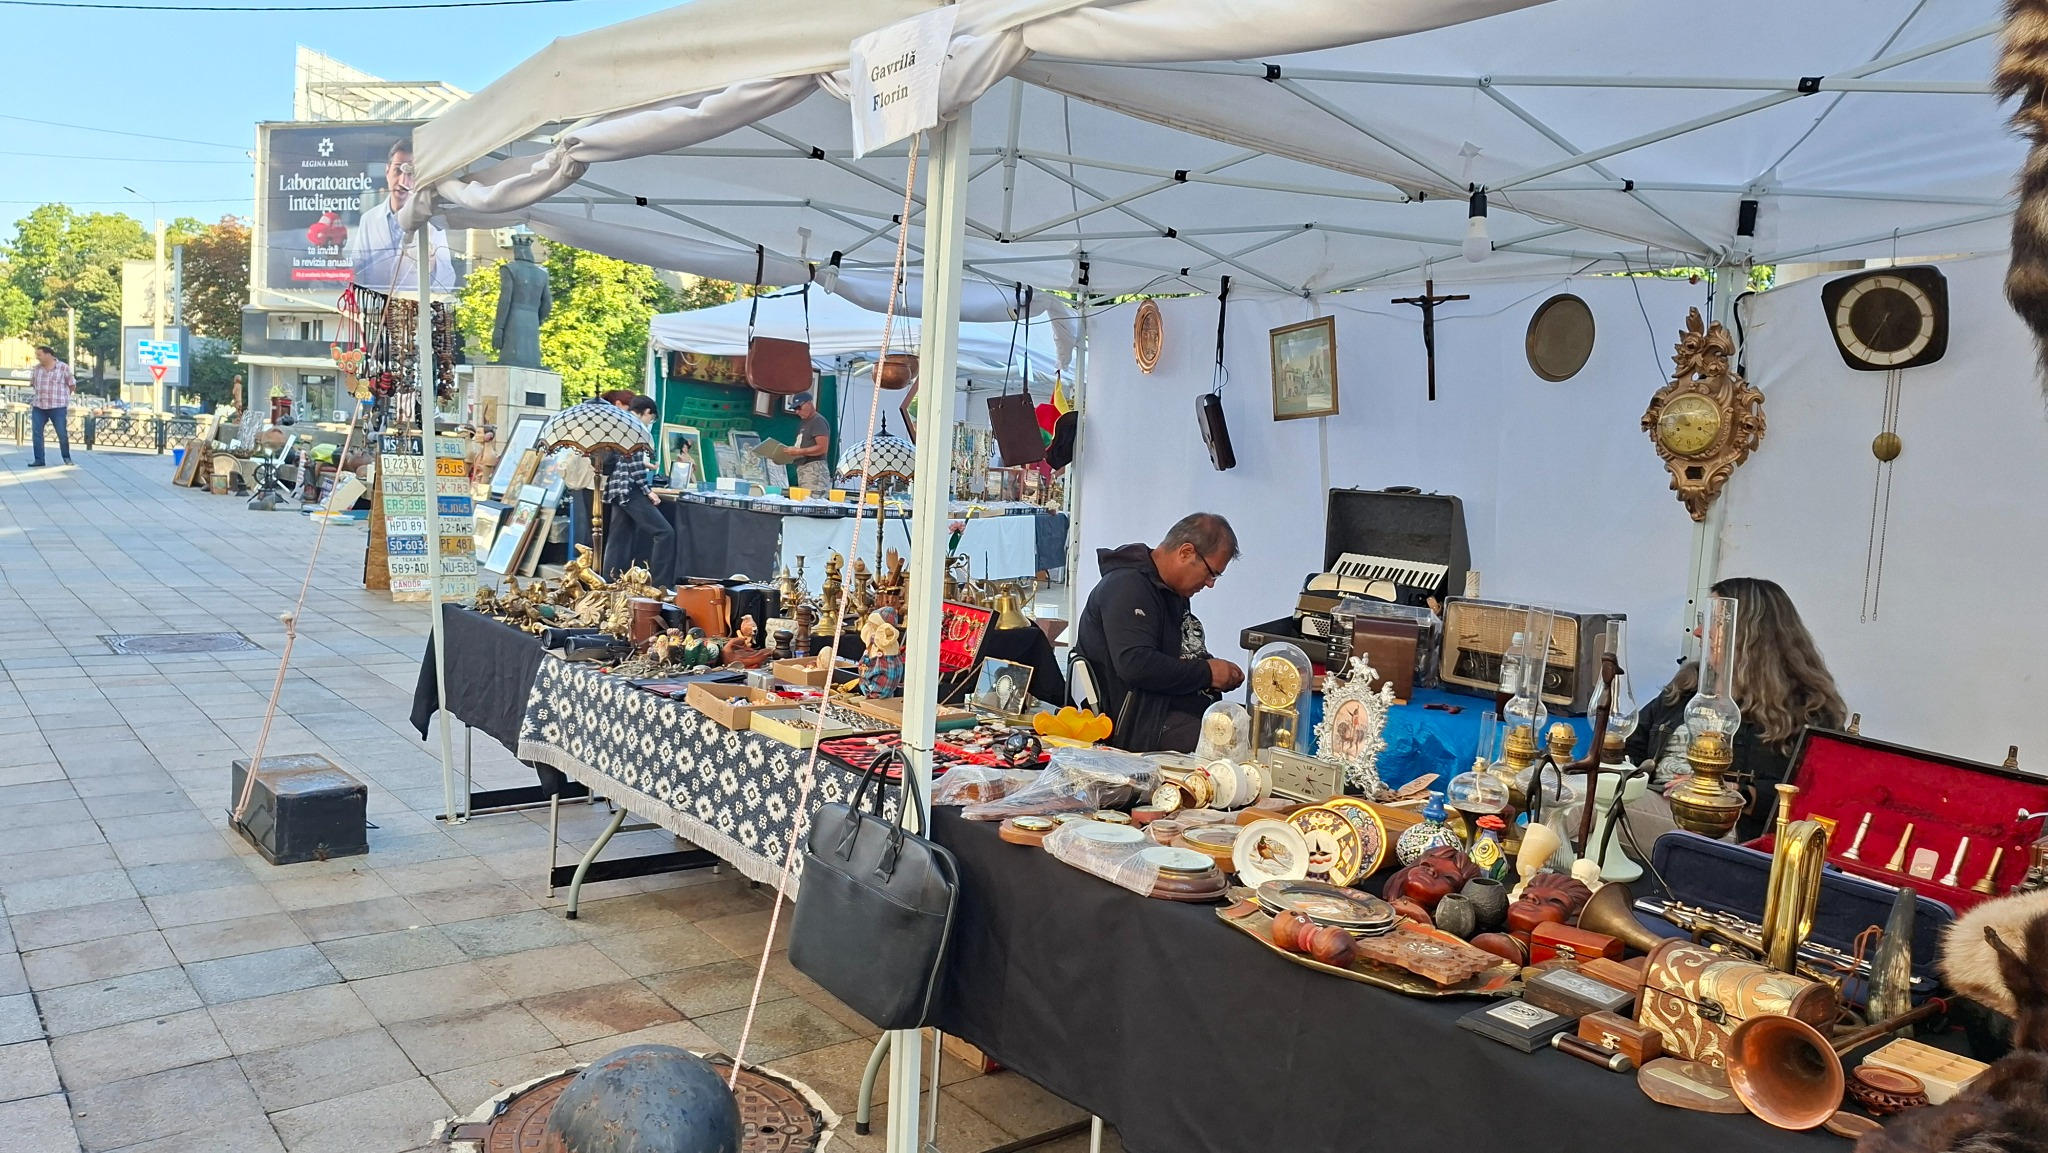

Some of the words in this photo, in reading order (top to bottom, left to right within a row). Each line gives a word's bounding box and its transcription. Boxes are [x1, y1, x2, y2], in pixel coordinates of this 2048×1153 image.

[871, 50, 916, 82] Gavrilă
[873, 84, 908, 111] Florin
[327, 159, 348, 167] MARIA
[279, 172, 372, 191] Laboratoarele
[289, 194, 360, 213] Inteligente
[293, 257, 300, 266] la
[302, 257, 326, 266] revizia
[437, 463, 463, 474] 98JS
